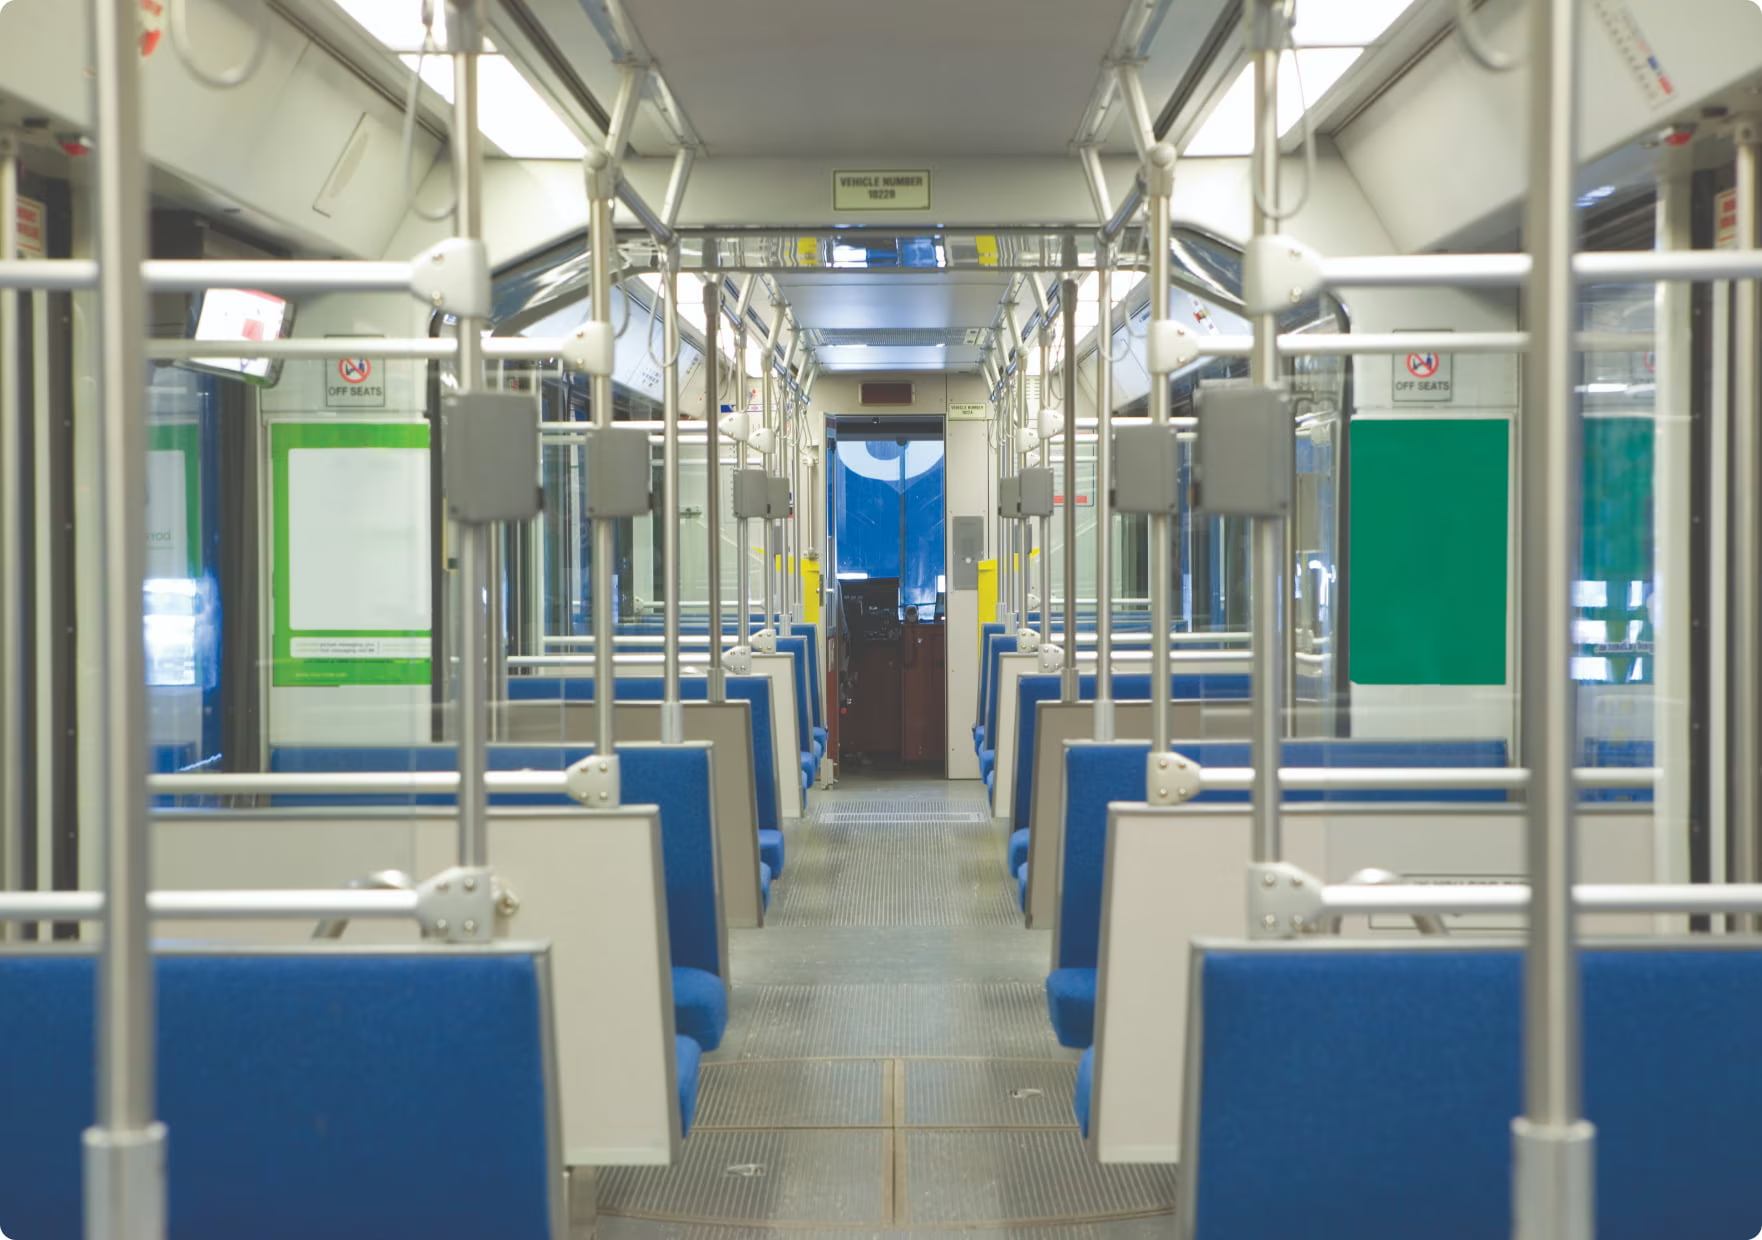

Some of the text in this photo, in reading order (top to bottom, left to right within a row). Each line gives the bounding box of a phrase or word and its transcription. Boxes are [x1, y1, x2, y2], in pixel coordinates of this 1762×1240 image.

[840, 175, 923, 188] VEHICLE NUMBER
[328, 386, 382, 396] OFF SEATS
[1395, 381, 1450, 391] OFF SEATS
